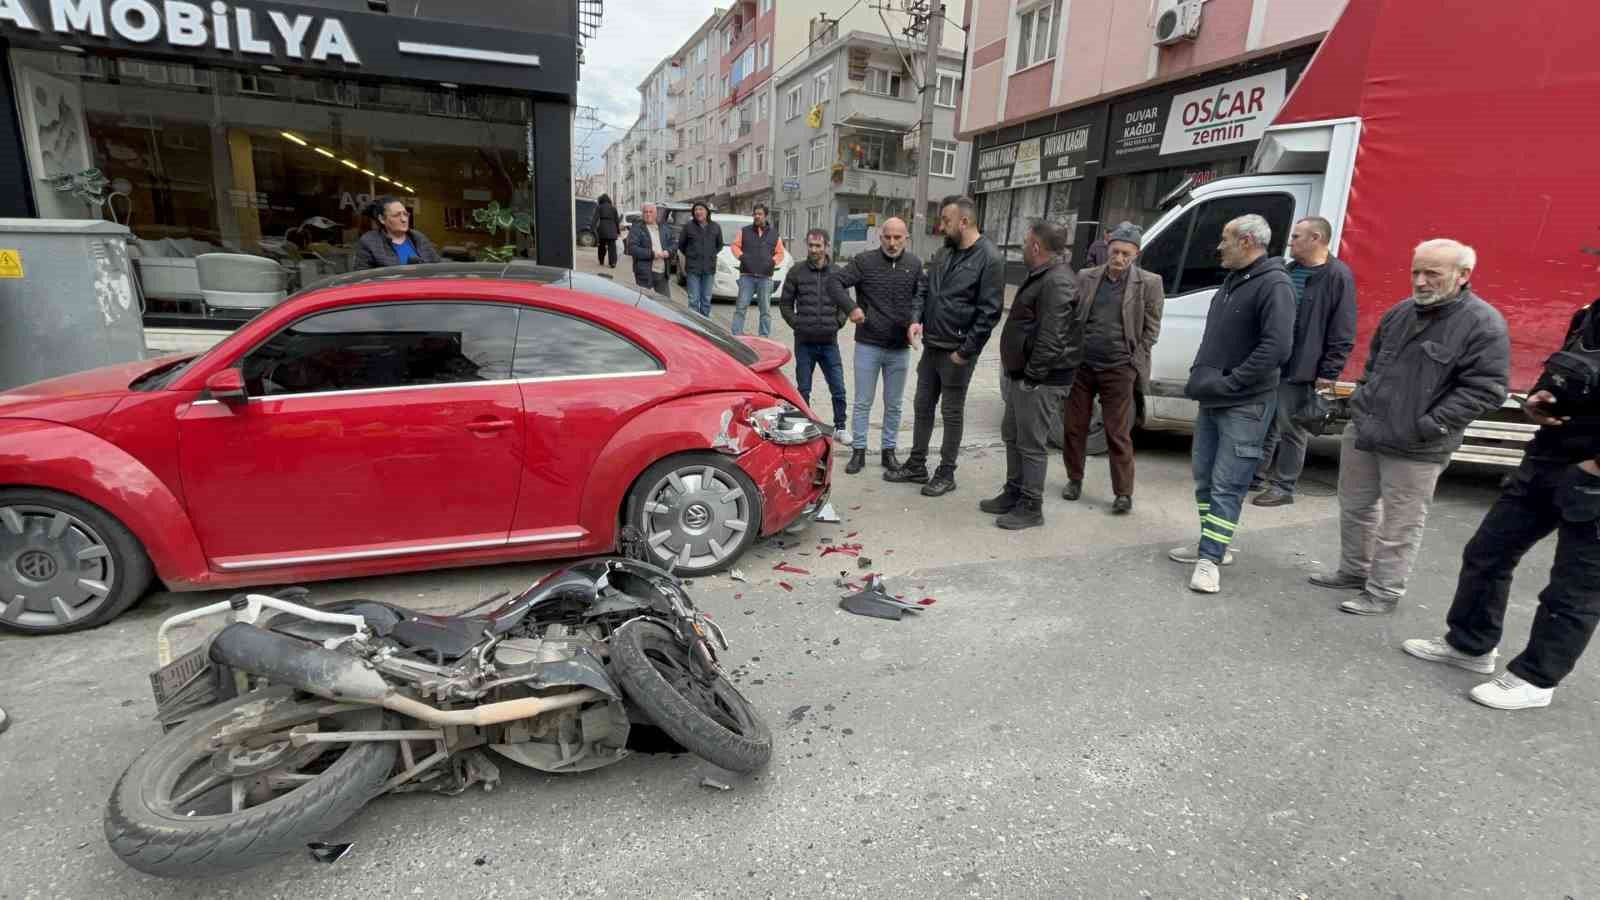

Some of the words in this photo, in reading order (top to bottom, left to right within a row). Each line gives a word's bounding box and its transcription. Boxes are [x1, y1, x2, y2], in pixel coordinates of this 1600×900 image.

[1125, 107, 1158, 124] DUVAR
[1182, 86, 1265, 126] OSCAR
[1123, 122, 1156, 138] KAĞIDI
[1192, 121, 1244, 146] zemin
